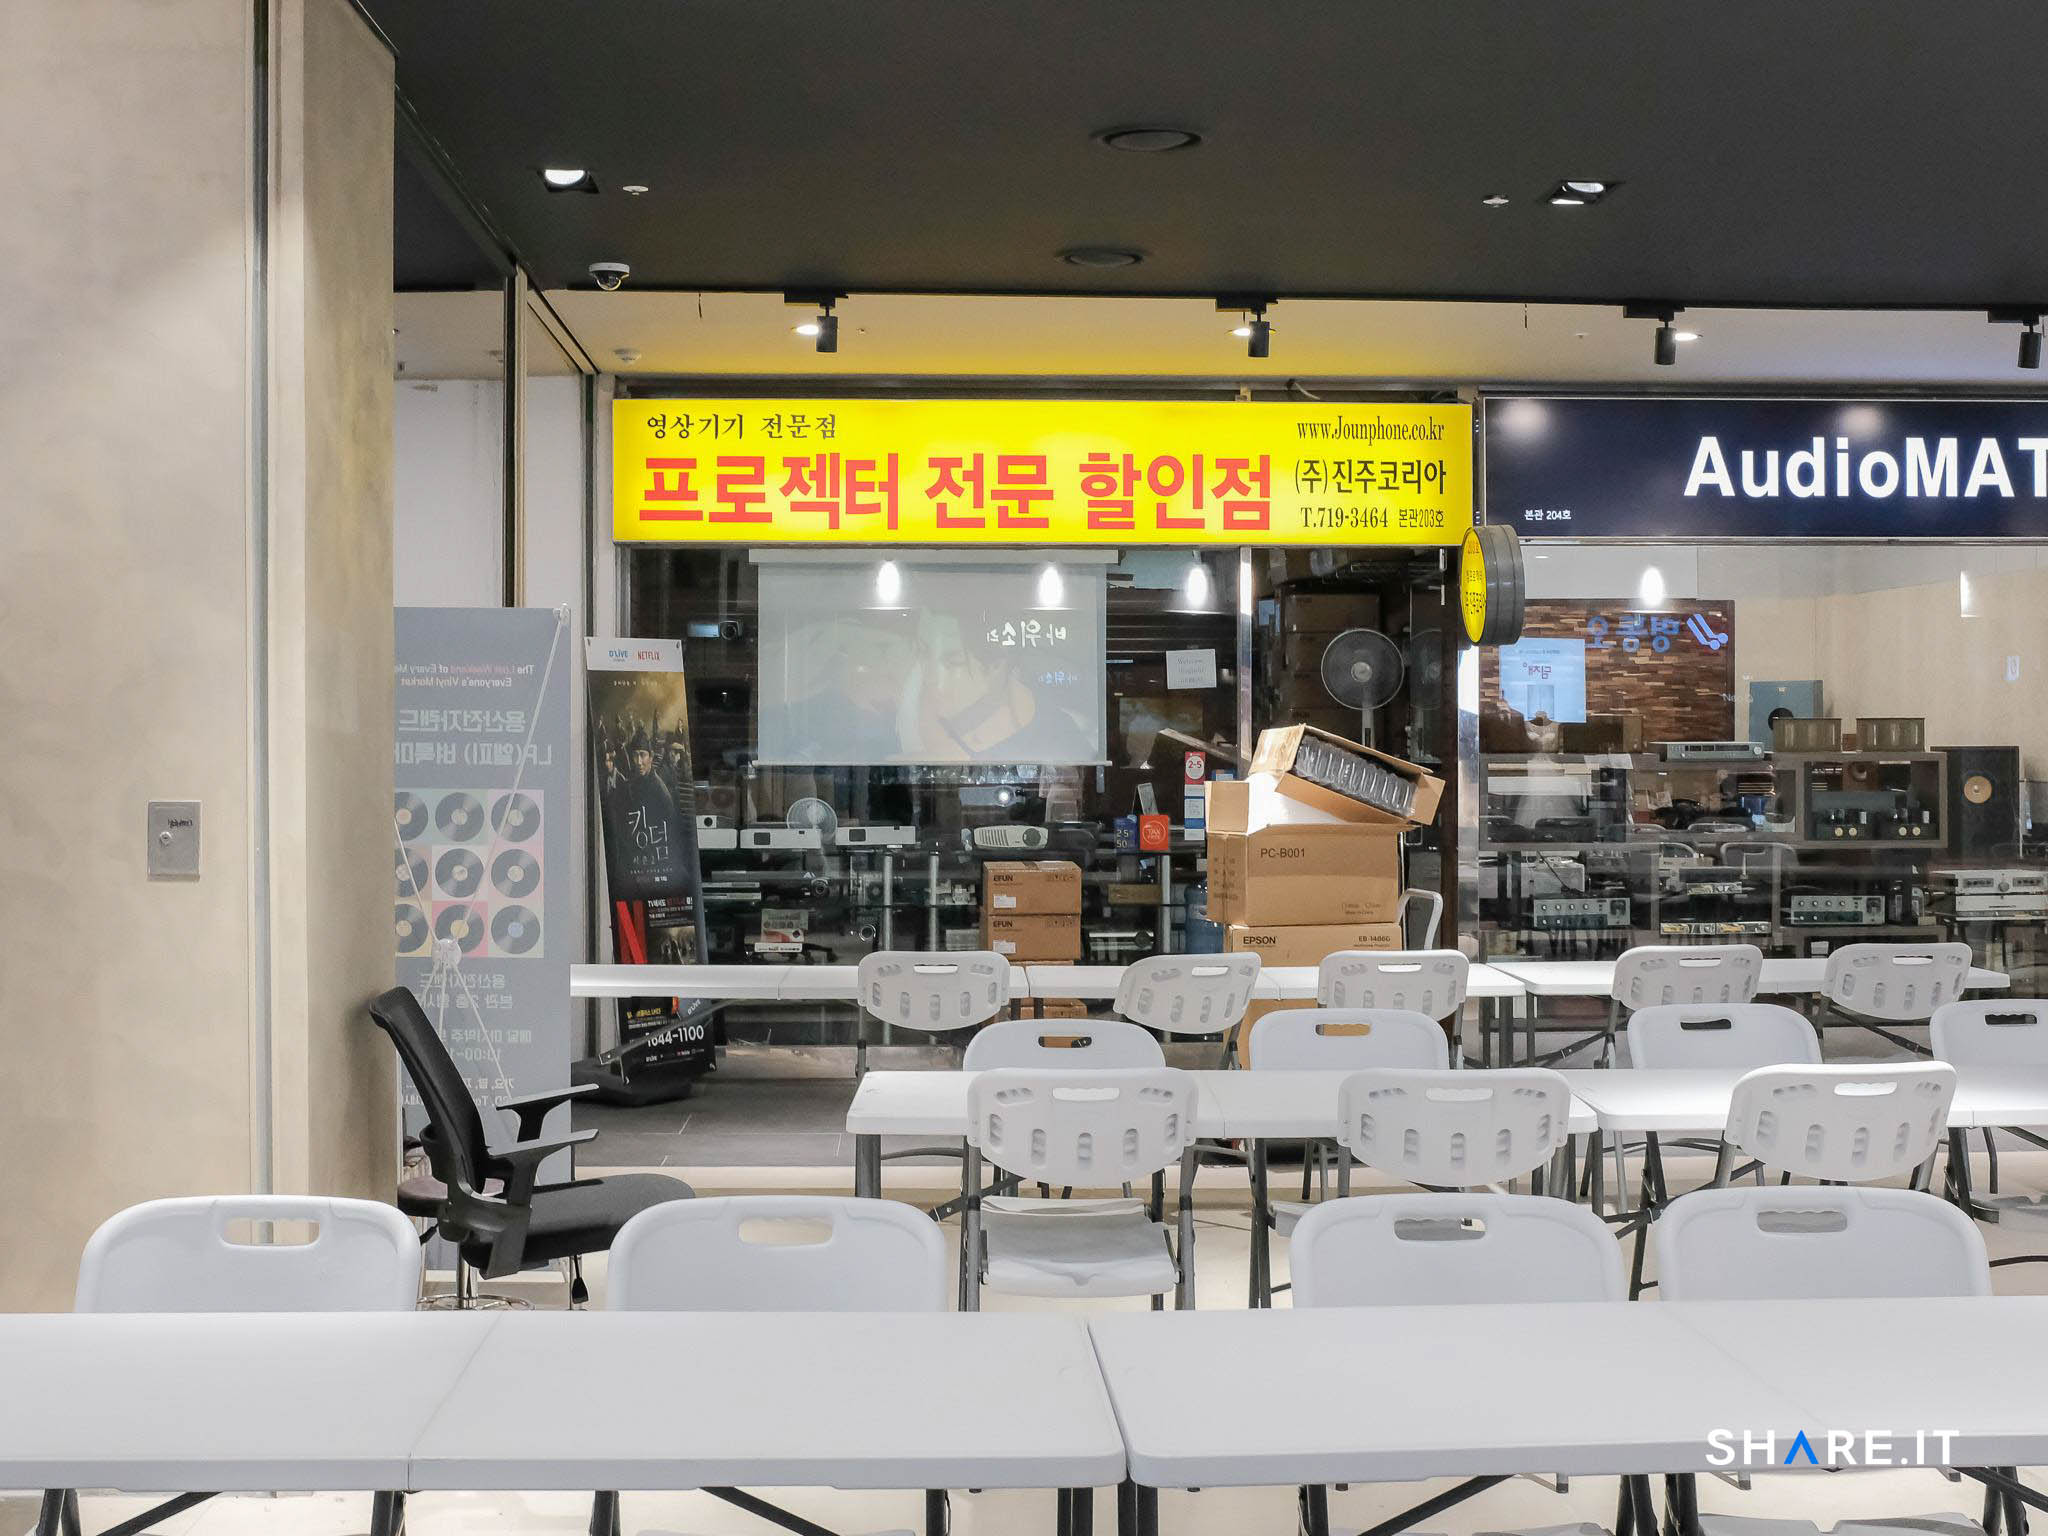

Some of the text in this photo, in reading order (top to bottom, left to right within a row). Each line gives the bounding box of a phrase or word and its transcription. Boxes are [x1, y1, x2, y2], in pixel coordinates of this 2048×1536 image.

[647, 413, 837, 439] 영상기기 전문점
[1297, 415, 1445, 446] www.Jounphone.co.kr
[1295, 458, 1447, 495] (주)진주코리아
[639, 452, 1271, 530] 프로젝터 전문 할인점
[1300, 506, 1445, 529] T.719-3464 본관203호
[1524, 509, 1572, 521] 본관 204호
[637, 650, 660, 661] NETFLIX
[1260, 847, 1305, 858] PC-B001
[1243, 935, 1276, 945] EPSON
